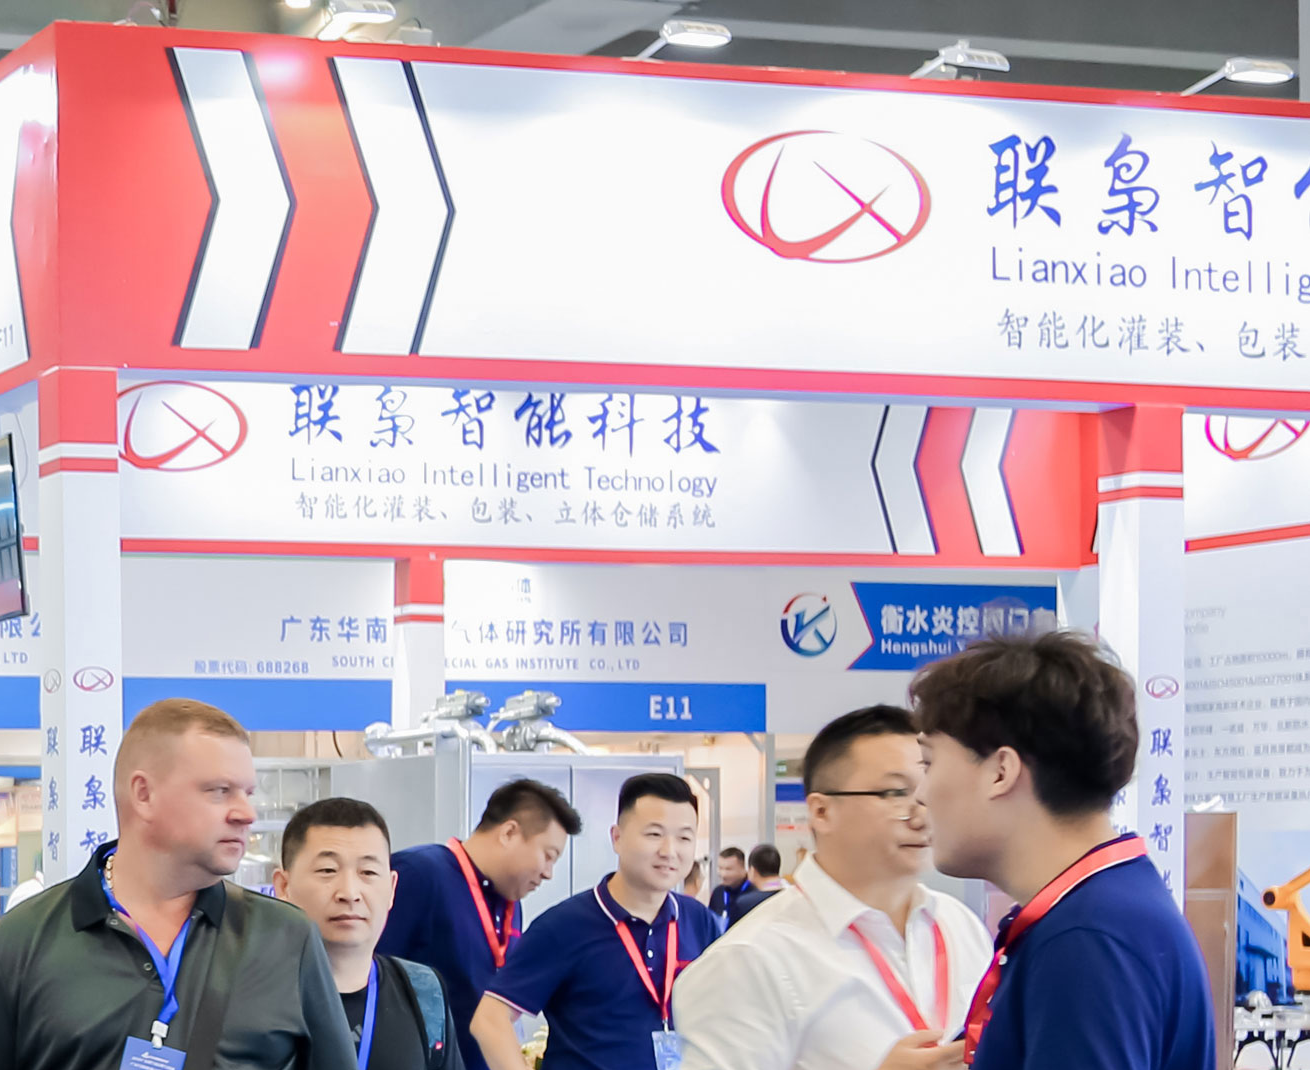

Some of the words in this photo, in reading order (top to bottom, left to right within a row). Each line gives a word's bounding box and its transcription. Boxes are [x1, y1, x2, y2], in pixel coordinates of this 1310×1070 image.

[986, 132, 1310, 241] 联枭智
[992, 247, 1147, 288] Lianxiao
[289, 385, 721, 457] 联枭智能科技
[292, 459, 405, 485] Lianxiao
[423, 461, 569, 493] Intelligent
[583, 467, 718, 498] Technology
[296, 491, 716, 530] 智能化灌装、包装、立体仓储系统
[332, 655, 375, 668] SOUTH
[881, 638, 952, 657] Hengshui
[256, 661, 310, 674] 688268
[485, 658, 509, 669] GAS
[516, 658, 579, 670] INSTITUTE
[649, 695, 693, 720] E11
